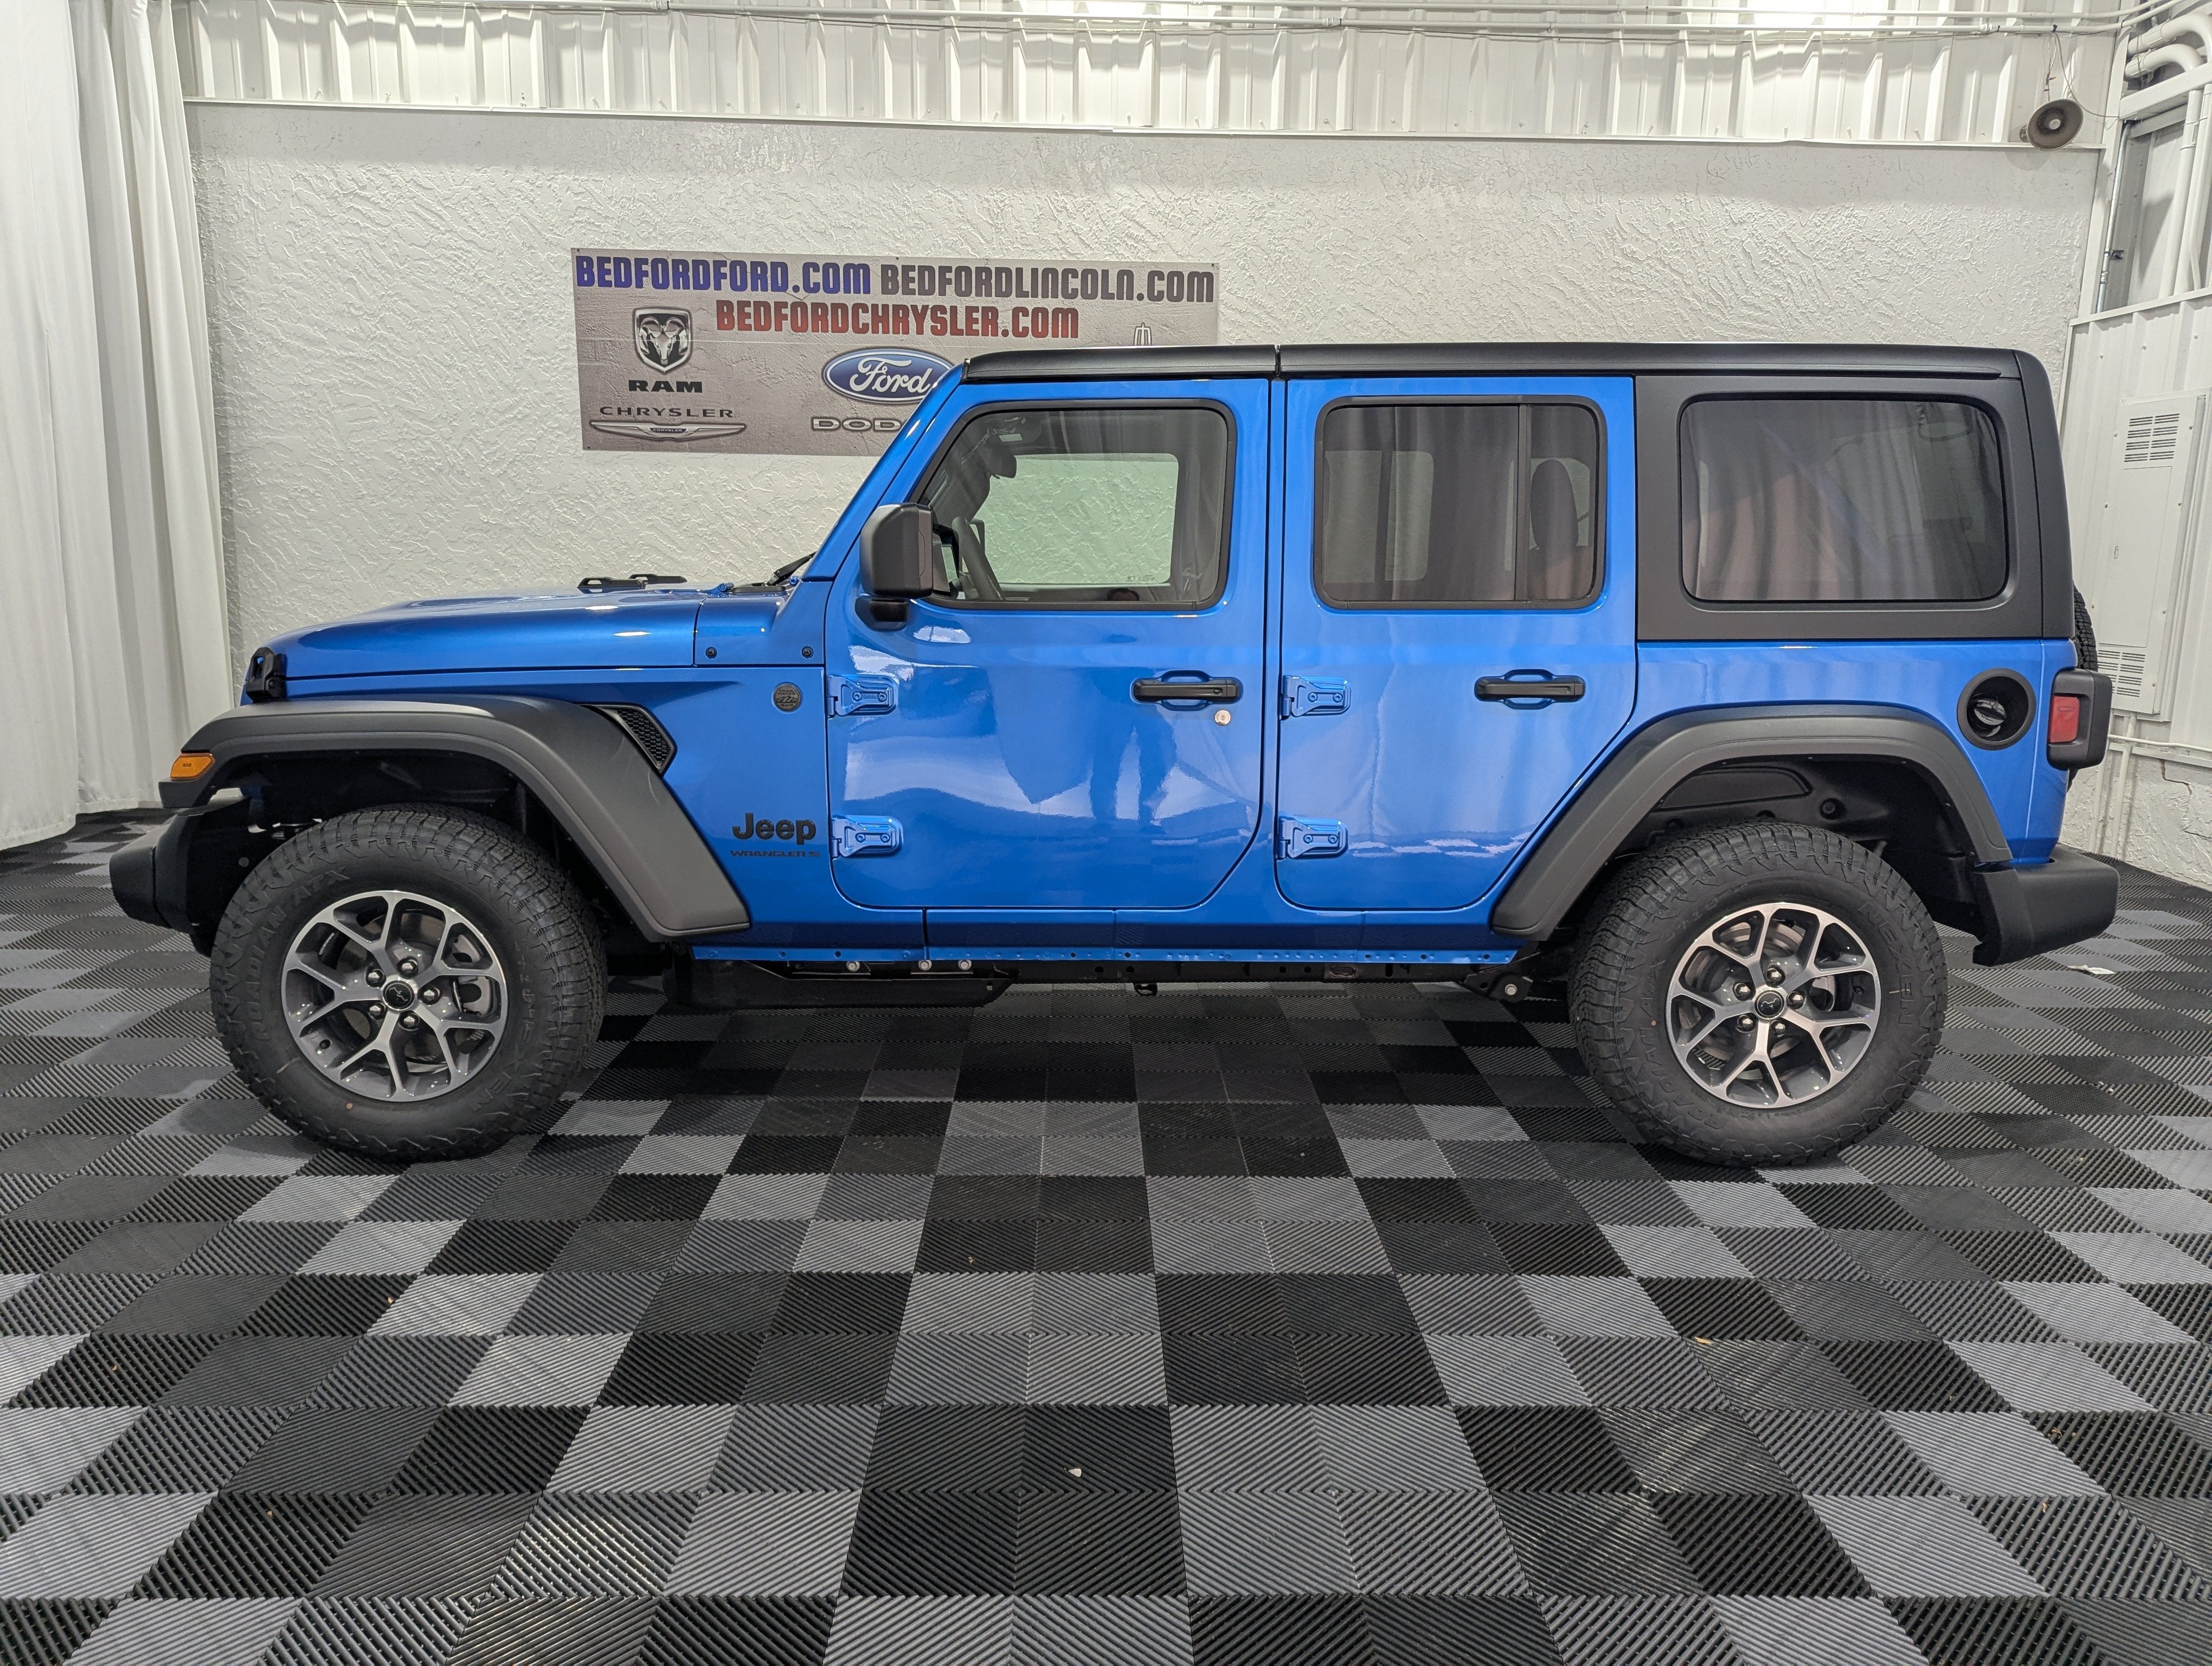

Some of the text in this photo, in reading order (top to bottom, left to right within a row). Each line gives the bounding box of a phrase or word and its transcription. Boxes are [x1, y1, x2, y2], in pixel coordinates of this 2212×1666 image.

[576, 255, 1214, 303] BEDFORDFORD.COM BEDFORDLINCOLN.COM
[716, 299, 1079, 338] BEDFORDCHRYSLER.COM
[628, 380, 703, 393] RAM
[849, 357, 933, 393] Ford
[600, 406, 734, 418] CHRYSLER
[812, 418, 903, 432] DOD
[732, 812, 816, 845] Jeep
